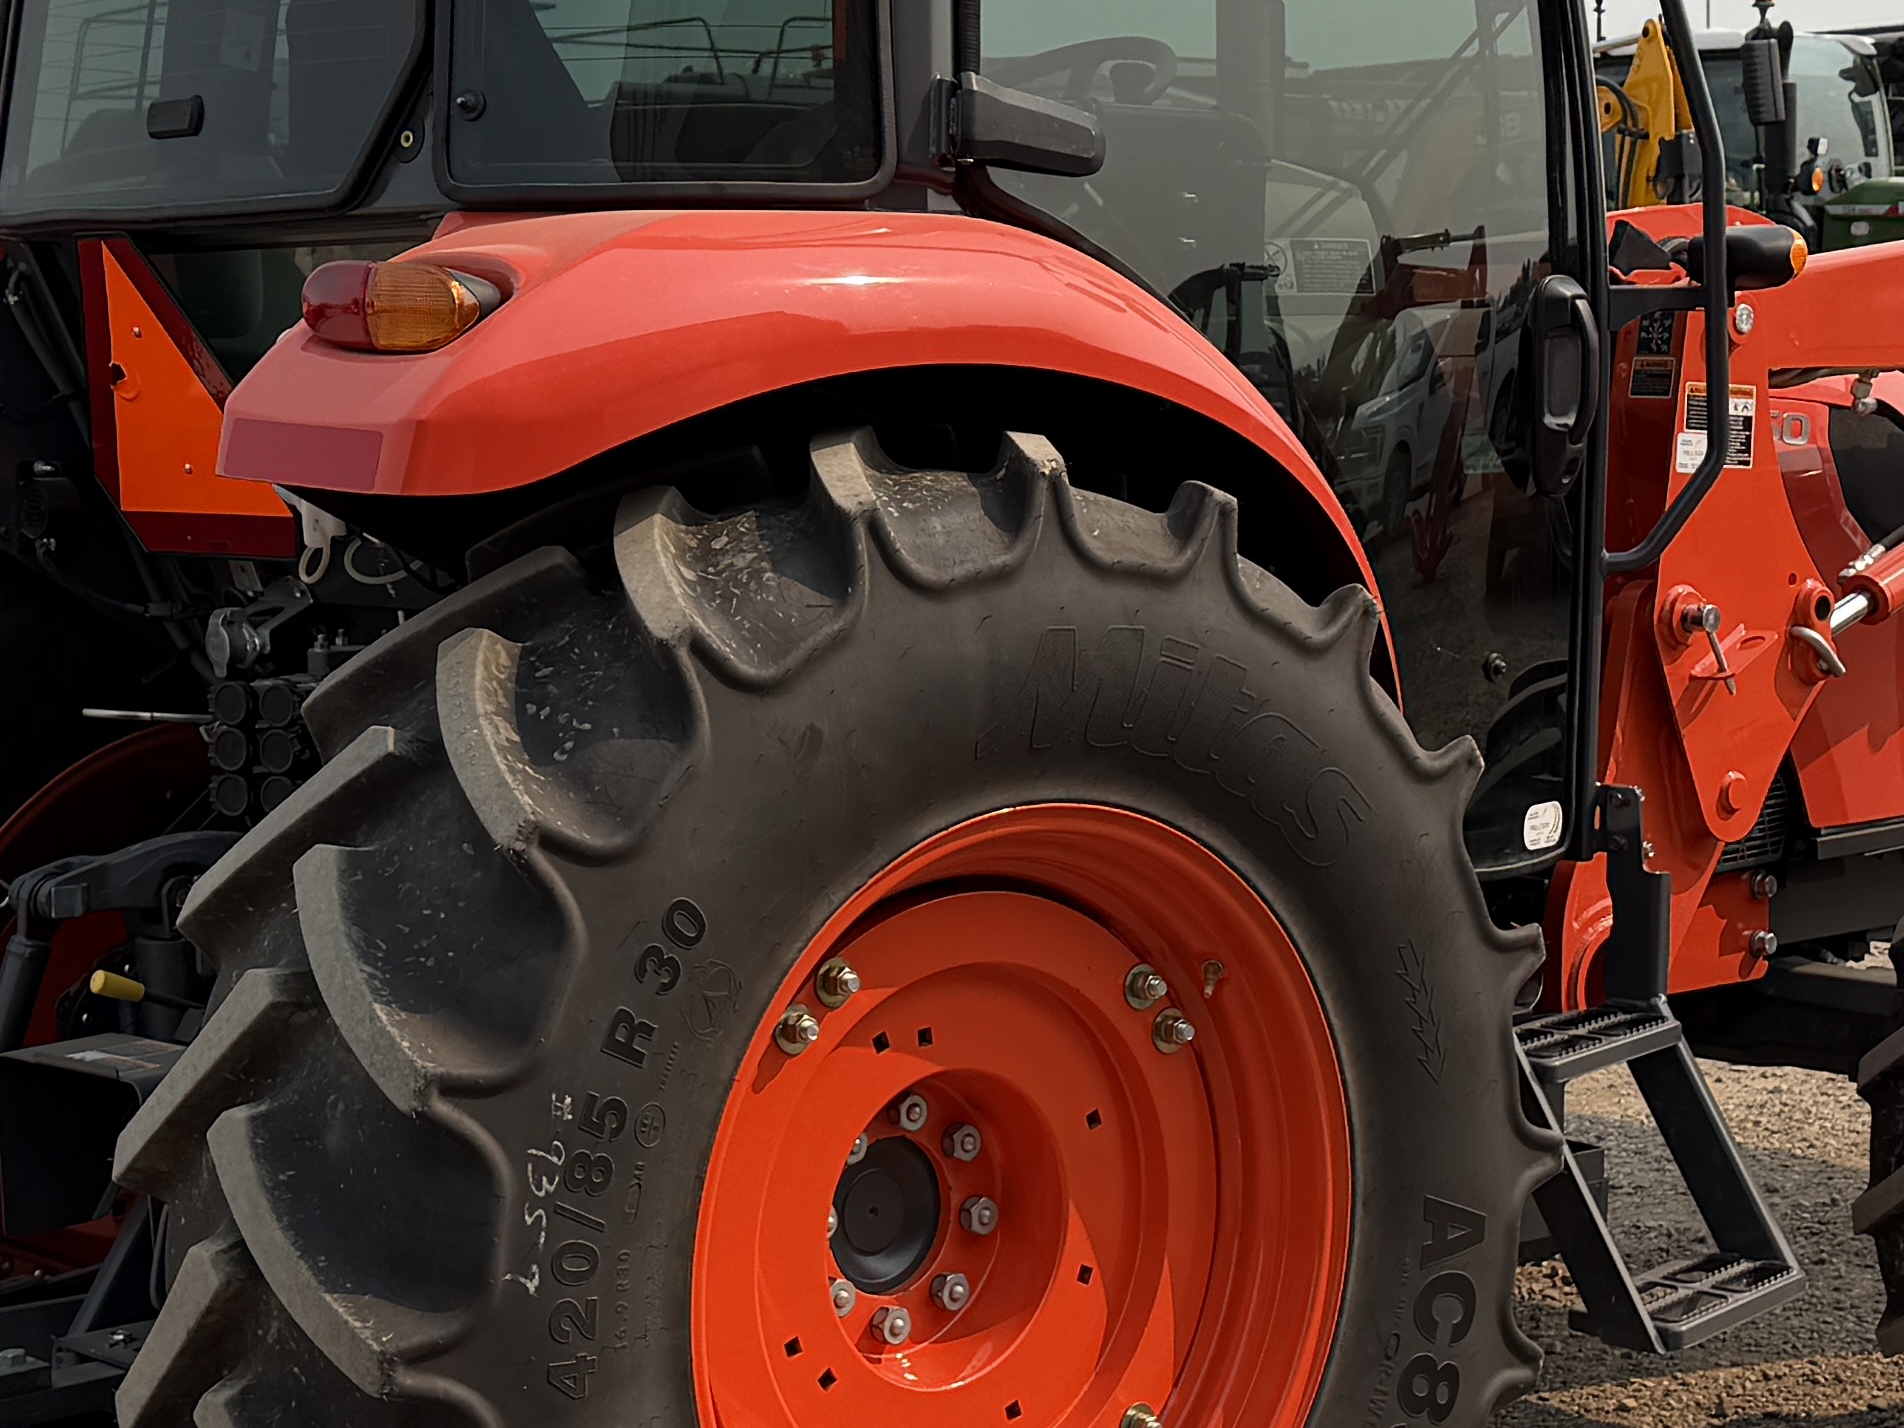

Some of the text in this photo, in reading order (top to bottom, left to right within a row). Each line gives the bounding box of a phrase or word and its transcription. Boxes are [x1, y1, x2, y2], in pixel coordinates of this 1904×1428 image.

[974, 624, 1373, 867] Mitas
[546, 896, 708, 1400] 420/85 R 30
